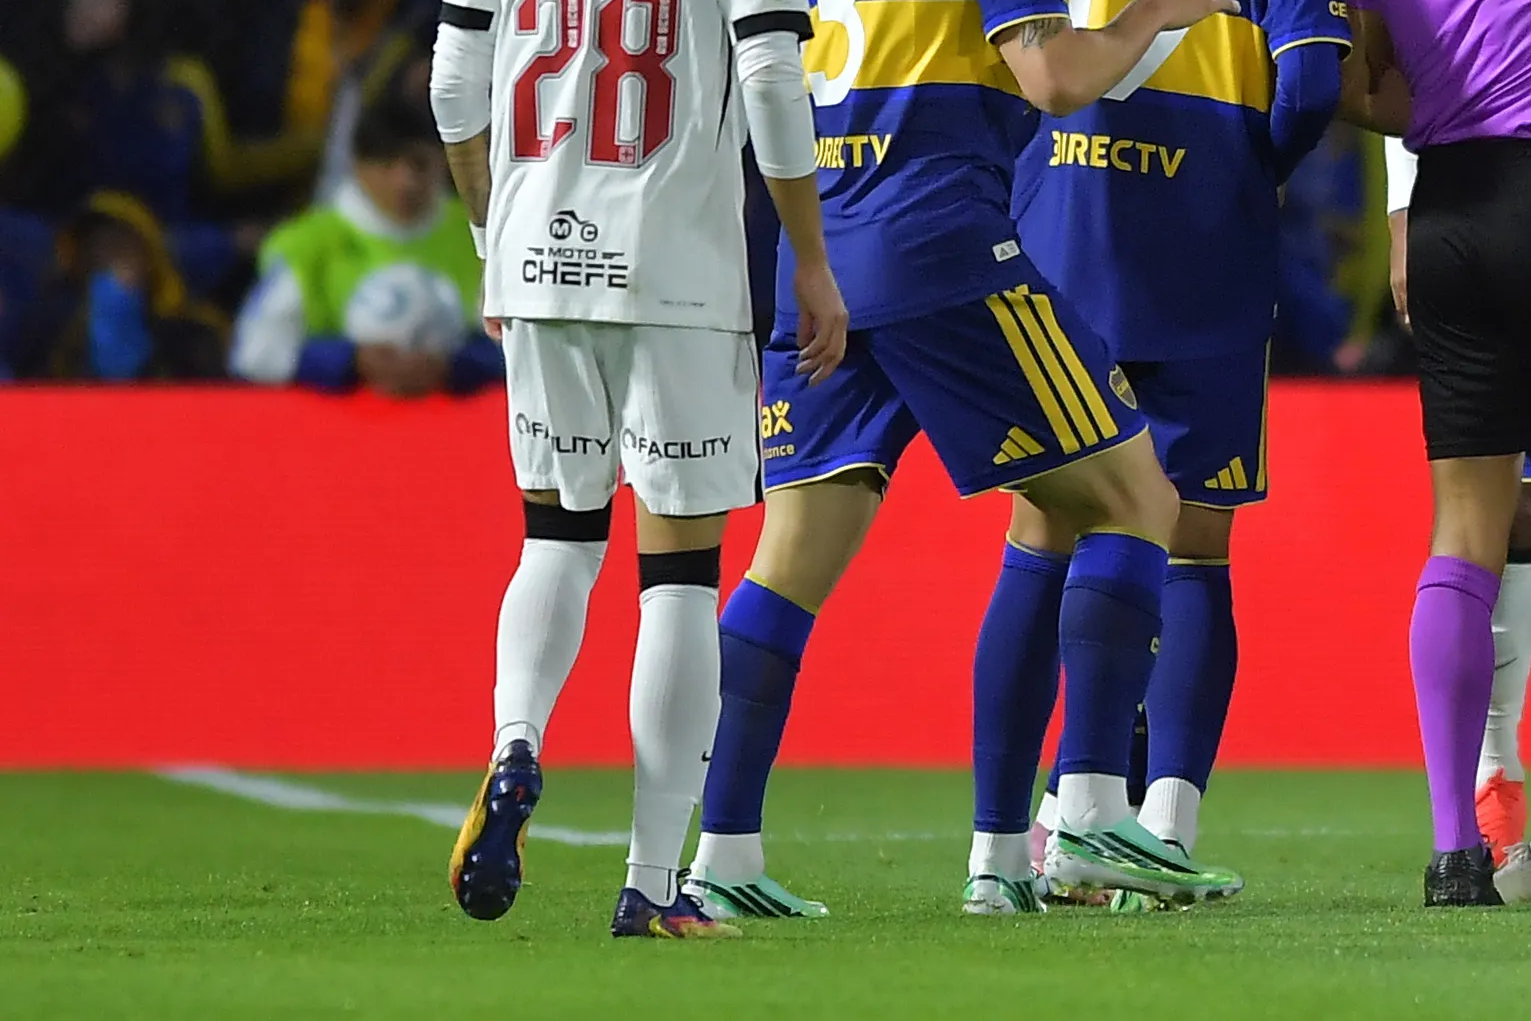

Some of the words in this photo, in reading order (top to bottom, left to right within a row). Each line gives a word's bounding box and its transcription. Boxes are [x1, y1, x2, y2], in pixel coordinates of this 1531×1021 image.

[548, 247, 597, 260] MOTO
[522, 260, 628, 289] CHEFE
[639, 435, 731, 459] FACILITY
